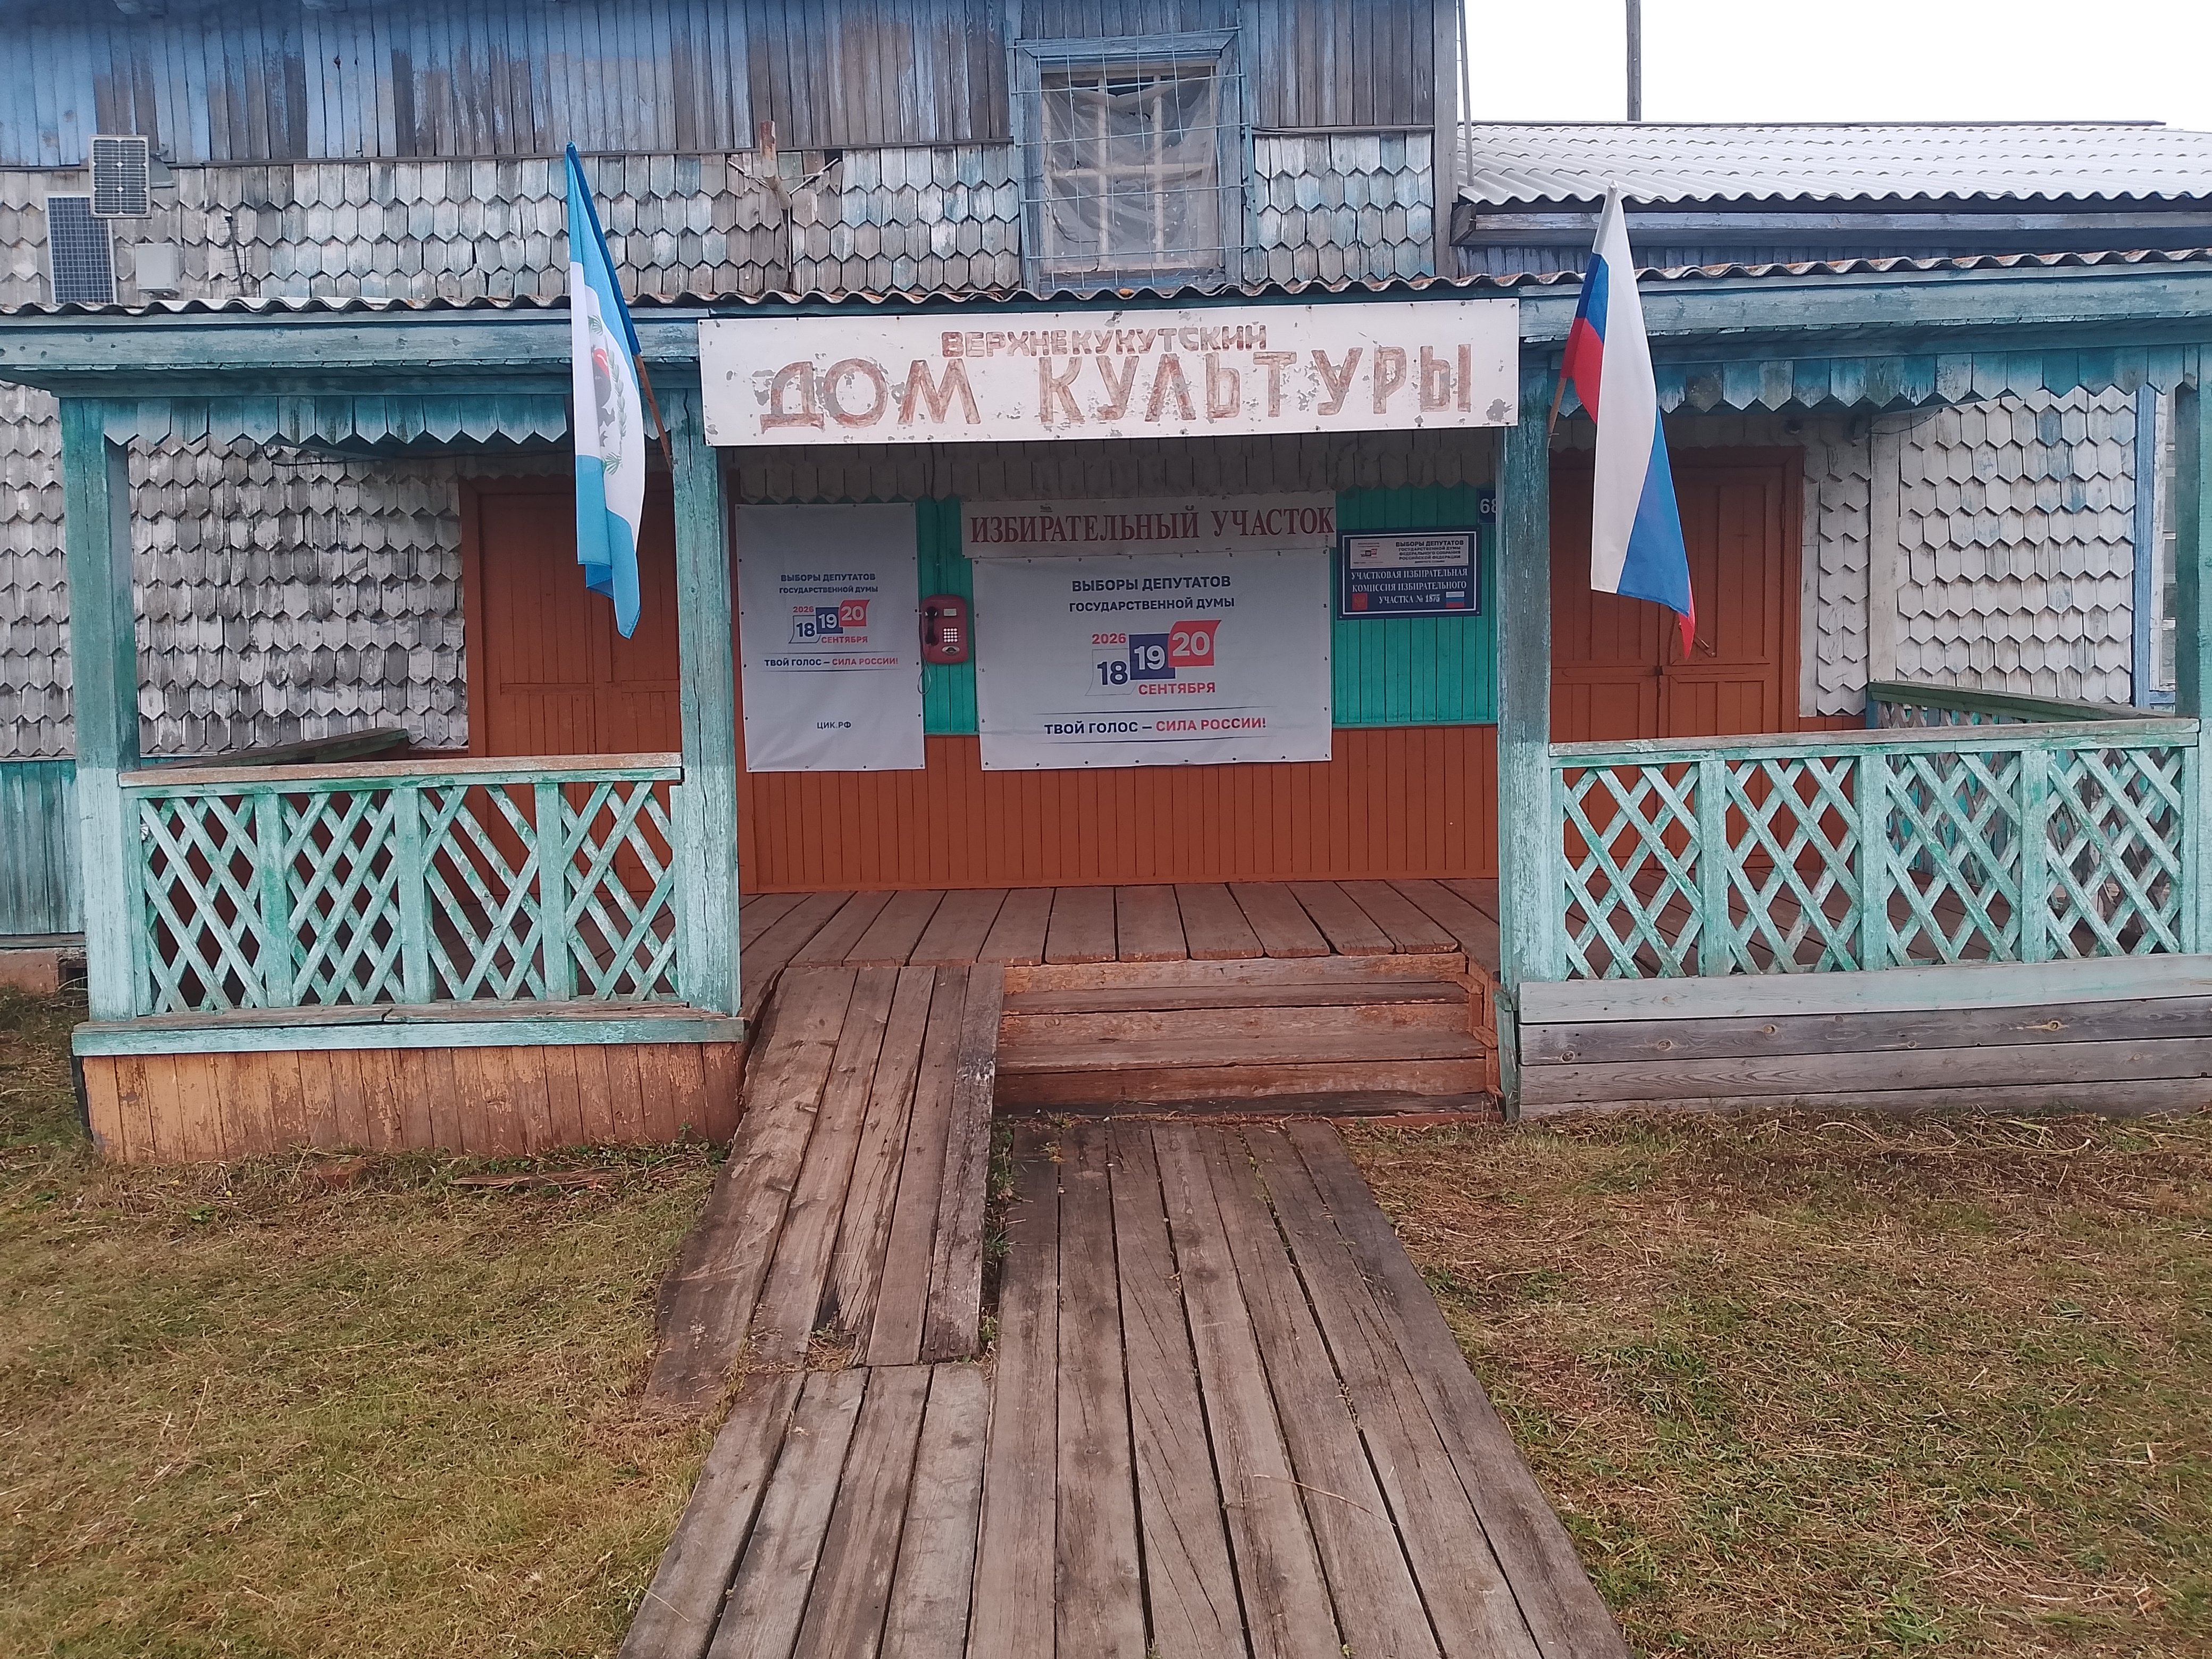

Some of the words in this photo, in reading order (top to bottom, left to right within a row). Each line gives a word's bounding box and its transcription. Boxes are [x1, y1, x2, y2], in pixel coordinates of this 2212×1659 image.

[941, 321, 1268, 357] ВЕРХНЕКУКУТСКИЙ
[760, 357, 982, 434] ДОМ
[1039, 343, 1471, 426] КУЛЬТУРЫ
[970, 505, 1200, 543] ИЗБИРАТЕЛЬНЫЙ
[1210, 507, 1335, 537] УЧАСТОК
[823, 573, 876, 582] ДЕПУТАТОВ
[1351, 571, 1402, 580] УЧАСТКОВАЯ
[1403, 568, 1468, 578] ИЗБИРАТЕЛЬНАЯ
[779, 585, 853, 594] ГОСУДАРСТВЕННОЙ
[1072, 579, 1138, 592] ВЫБОРЫ
[1142, 576, 1231, 591] ДЕПУТАТОВ
[1352, 583, 1396, 592] КОМИССИЯ
[1398, 581, 1467, 591] ИЗБИРАТЕЛЬНОГО
[1069, 597, 1193, 613] ГОСУДАРСТВЕННОЙ
[1196, 598, 1234, 609] ДУМЫ
[1378, 595, 1414, 604] УЧАСТКА
[1415, 594, 1423, 603] №
[1425, 594, 1440, 602] 1875
[796, 622, 815, 637] 18
[818, 614, 837, 629] 19
[841, 606, 865, 621] 20
[1092, 633, 1126, 644] 2026
[764, 658, 789, 666] ТВОЙ
[1097, 661, 1128, 685] 18
[1134, 645, 1165, 670] 19
[1172, 631, 1210, 656] 20
[1138, 682, 1216, 696] СЕНТЯБРЯ
[817, 720, 851, 730] ЦИК.РФ
[1044, 721, 1084, 735] ТВОЙ
[1089, 722, 1138, 734] ГОЛОС
[1156, 719, 1196, 733] СИЛА
[1201, 717, 1266, 731] РОССИИ!
